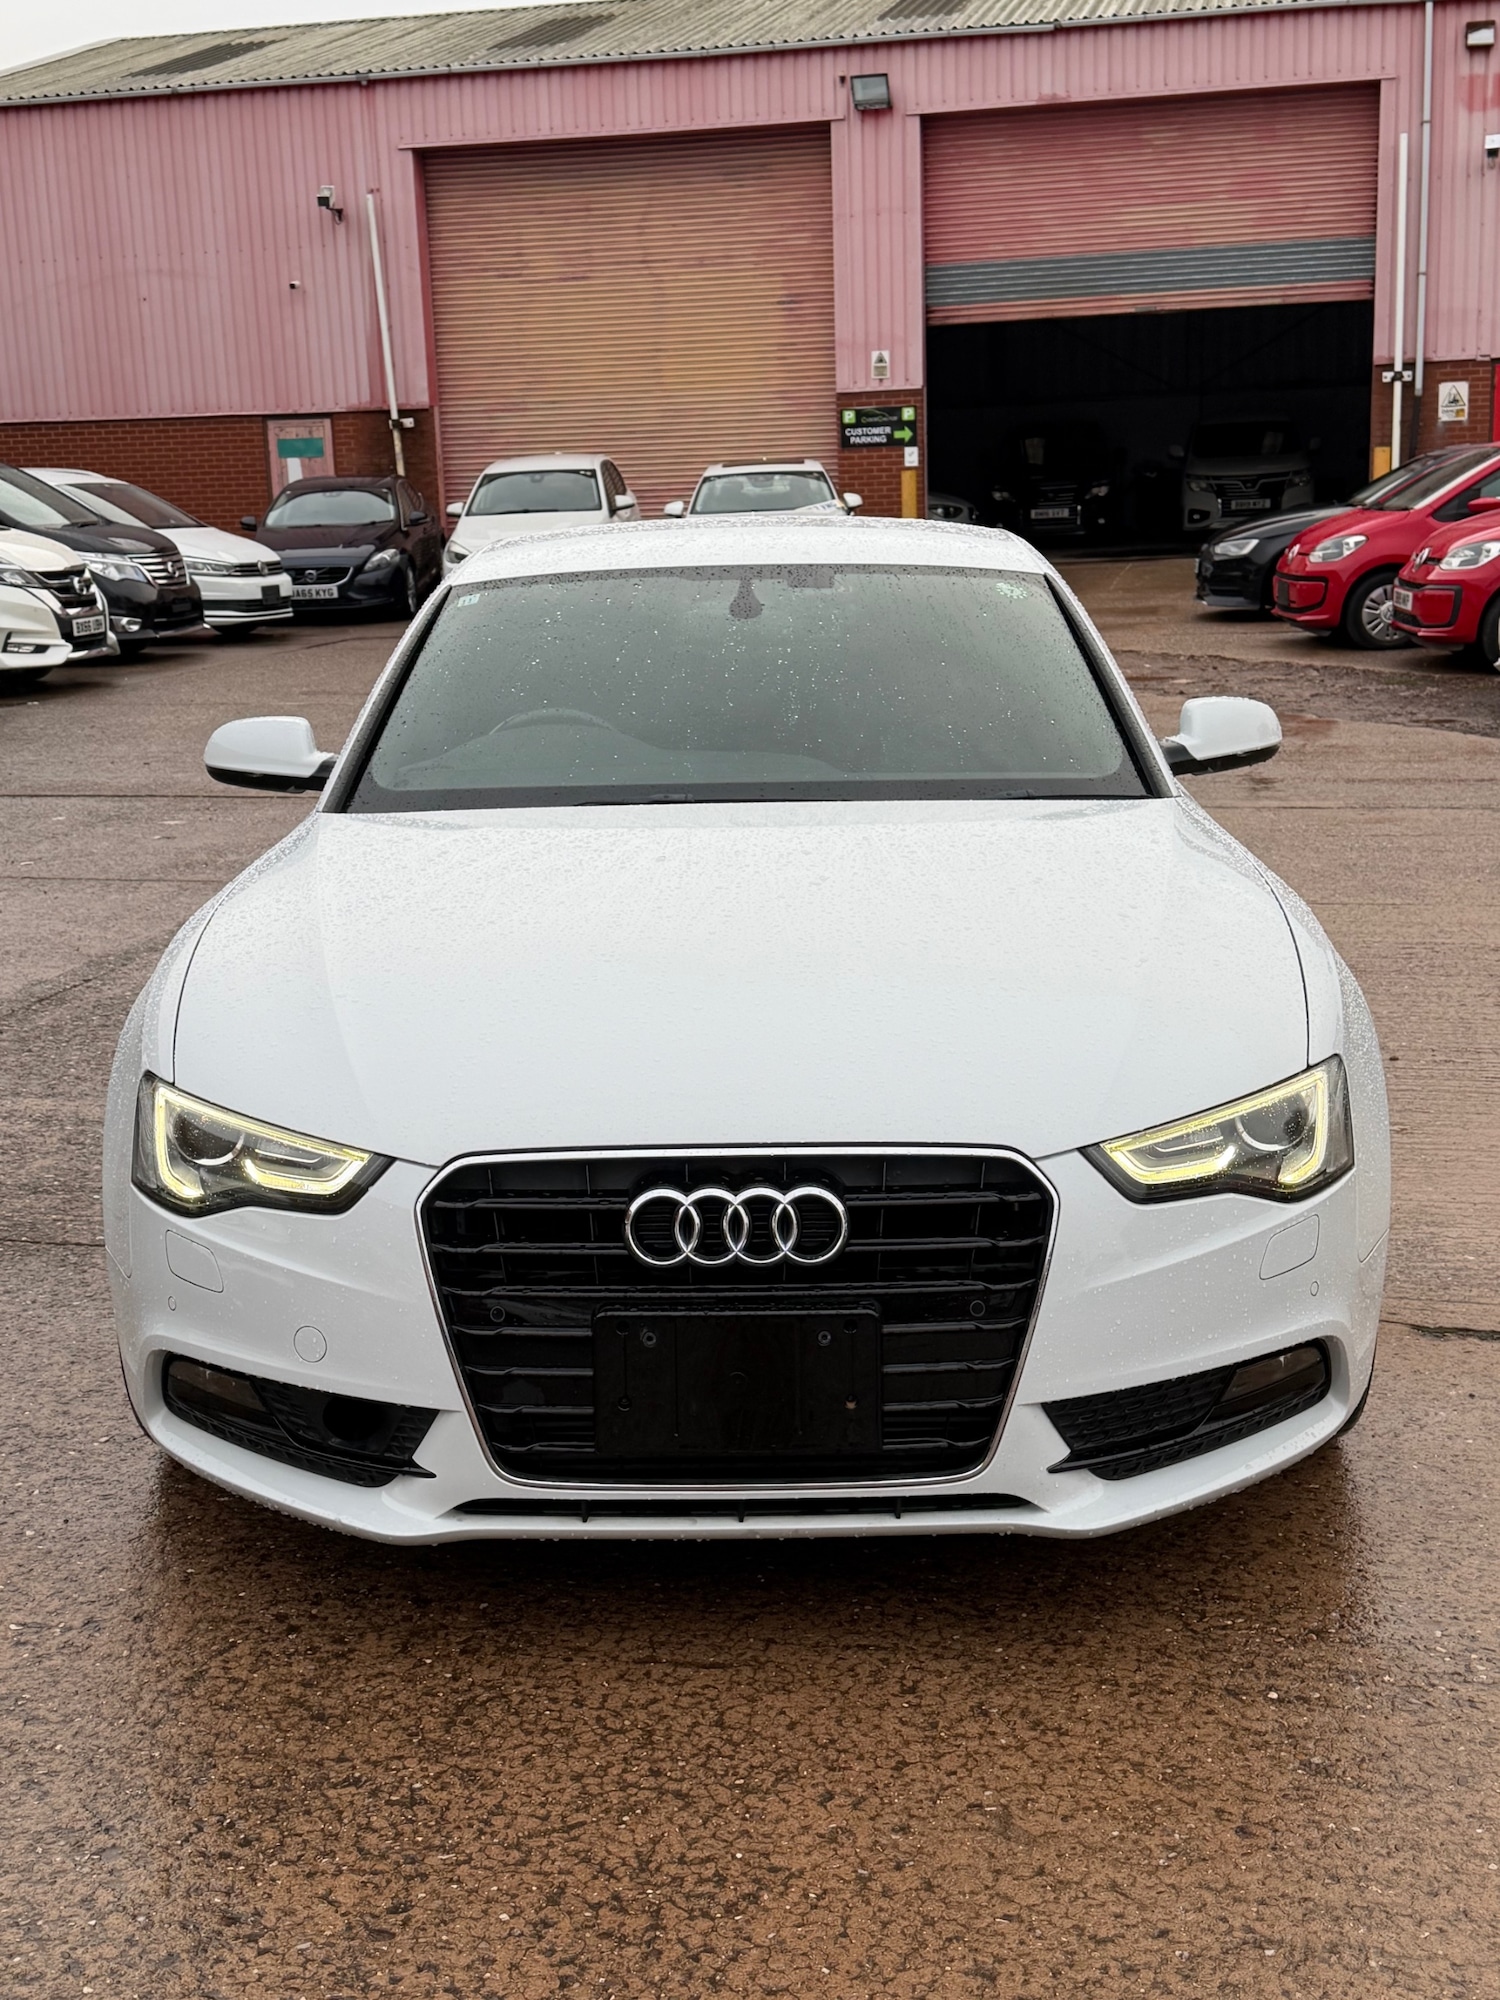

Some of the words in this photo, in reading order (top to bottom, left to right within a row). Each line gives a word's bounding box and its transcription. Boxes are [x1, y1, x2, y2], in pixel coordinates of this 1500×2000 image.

[844, 426, 892, 436] CUSTOMER
[849, 435, 888, 445] PARKING
[315, 587, 334, 598] KYG
